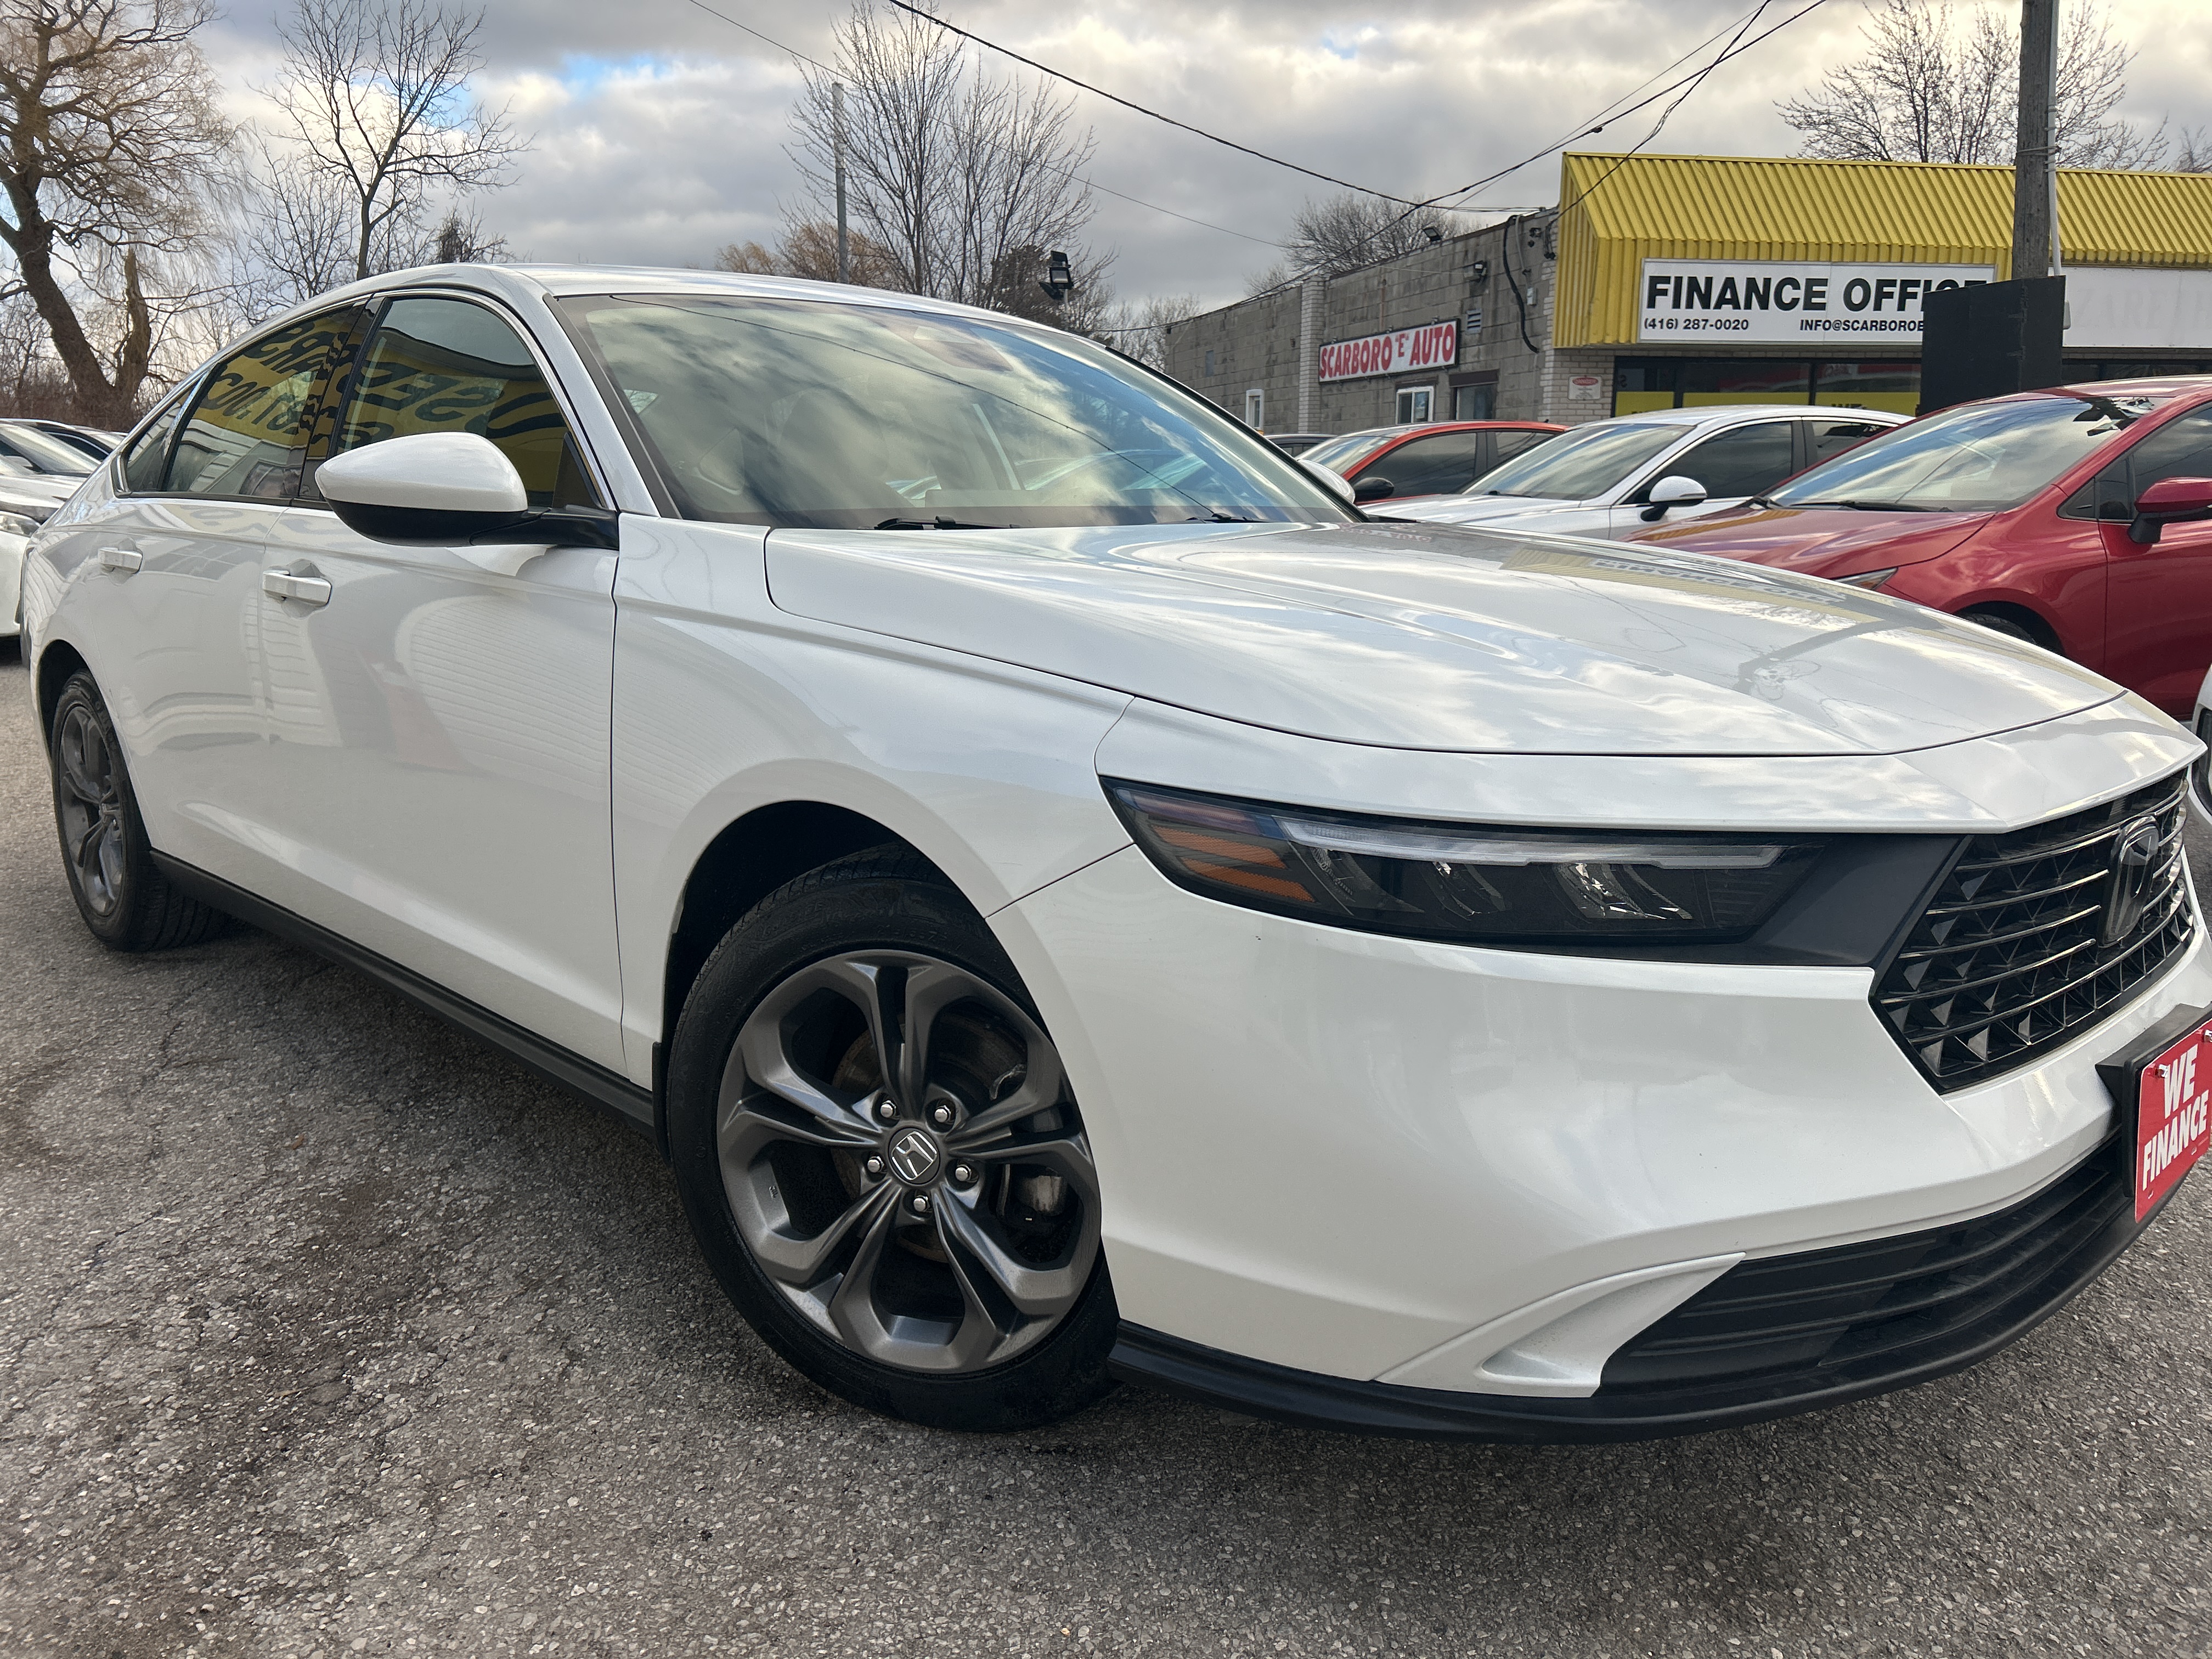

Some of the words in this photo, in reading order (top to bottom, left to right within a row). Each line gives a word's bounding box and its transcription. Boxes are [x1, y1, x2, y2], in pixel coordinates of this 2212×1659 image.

[1647, 275, 1829, 311] FINANCE
[1319, 336, 1392, 379] SCARBORO
[1409, 324, 1454, 366] AUTO
[1644, 318, 1678, 330] (416)
[1683, 319, 1749, 331] 287-0020
[2164, 1043, 2198, 1119] WE
[2142, 1089, 2209, 1191] FINANCE
